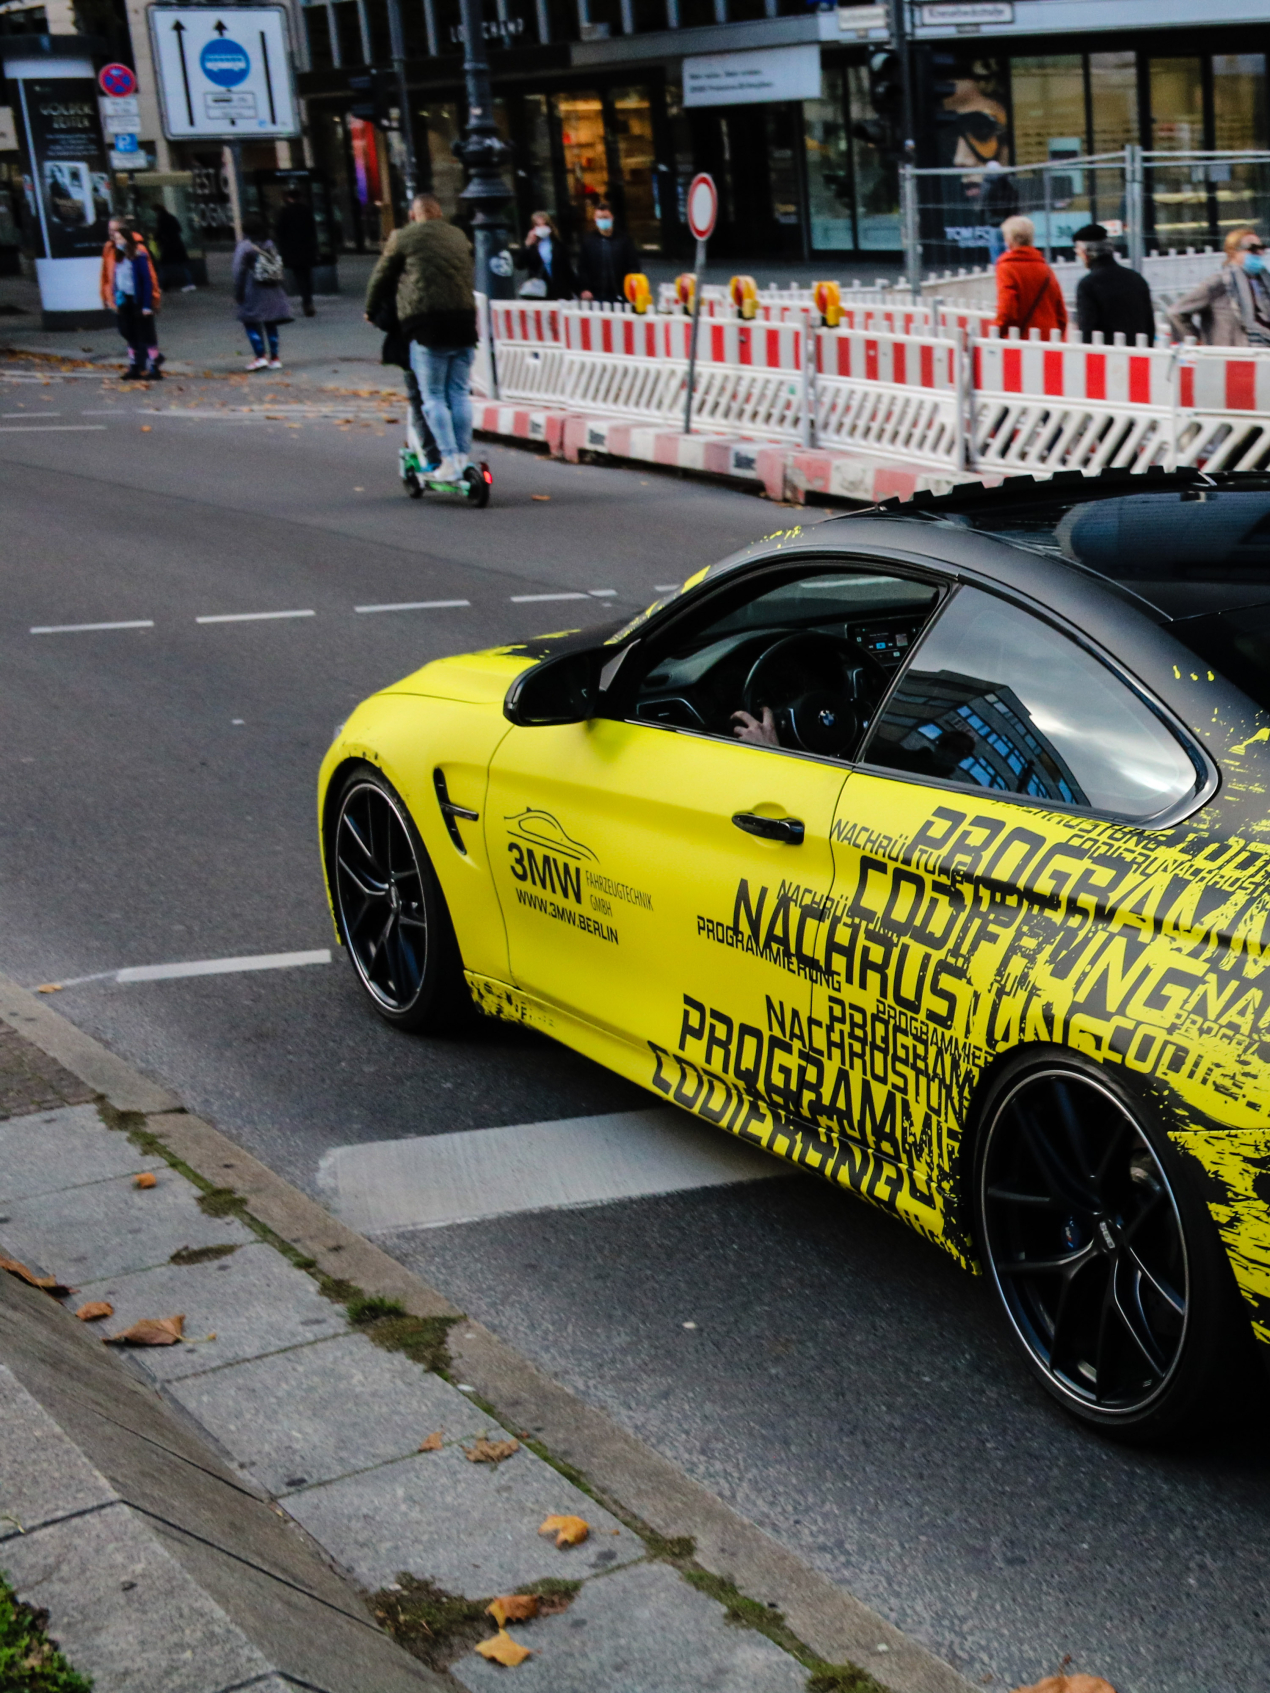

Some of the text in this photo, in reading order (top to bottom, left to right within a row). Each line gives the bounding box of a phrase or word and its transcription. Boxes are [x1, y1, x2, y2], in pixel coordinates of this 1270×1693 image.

[507, 842, 582, 904] 3MW
[585, 870, 654, 911] FAHRZEUGTECHNIK
[516, 887, 619, 945] WWW.3MW.BERLIN
[590, 894, 613, 917] GMBH
